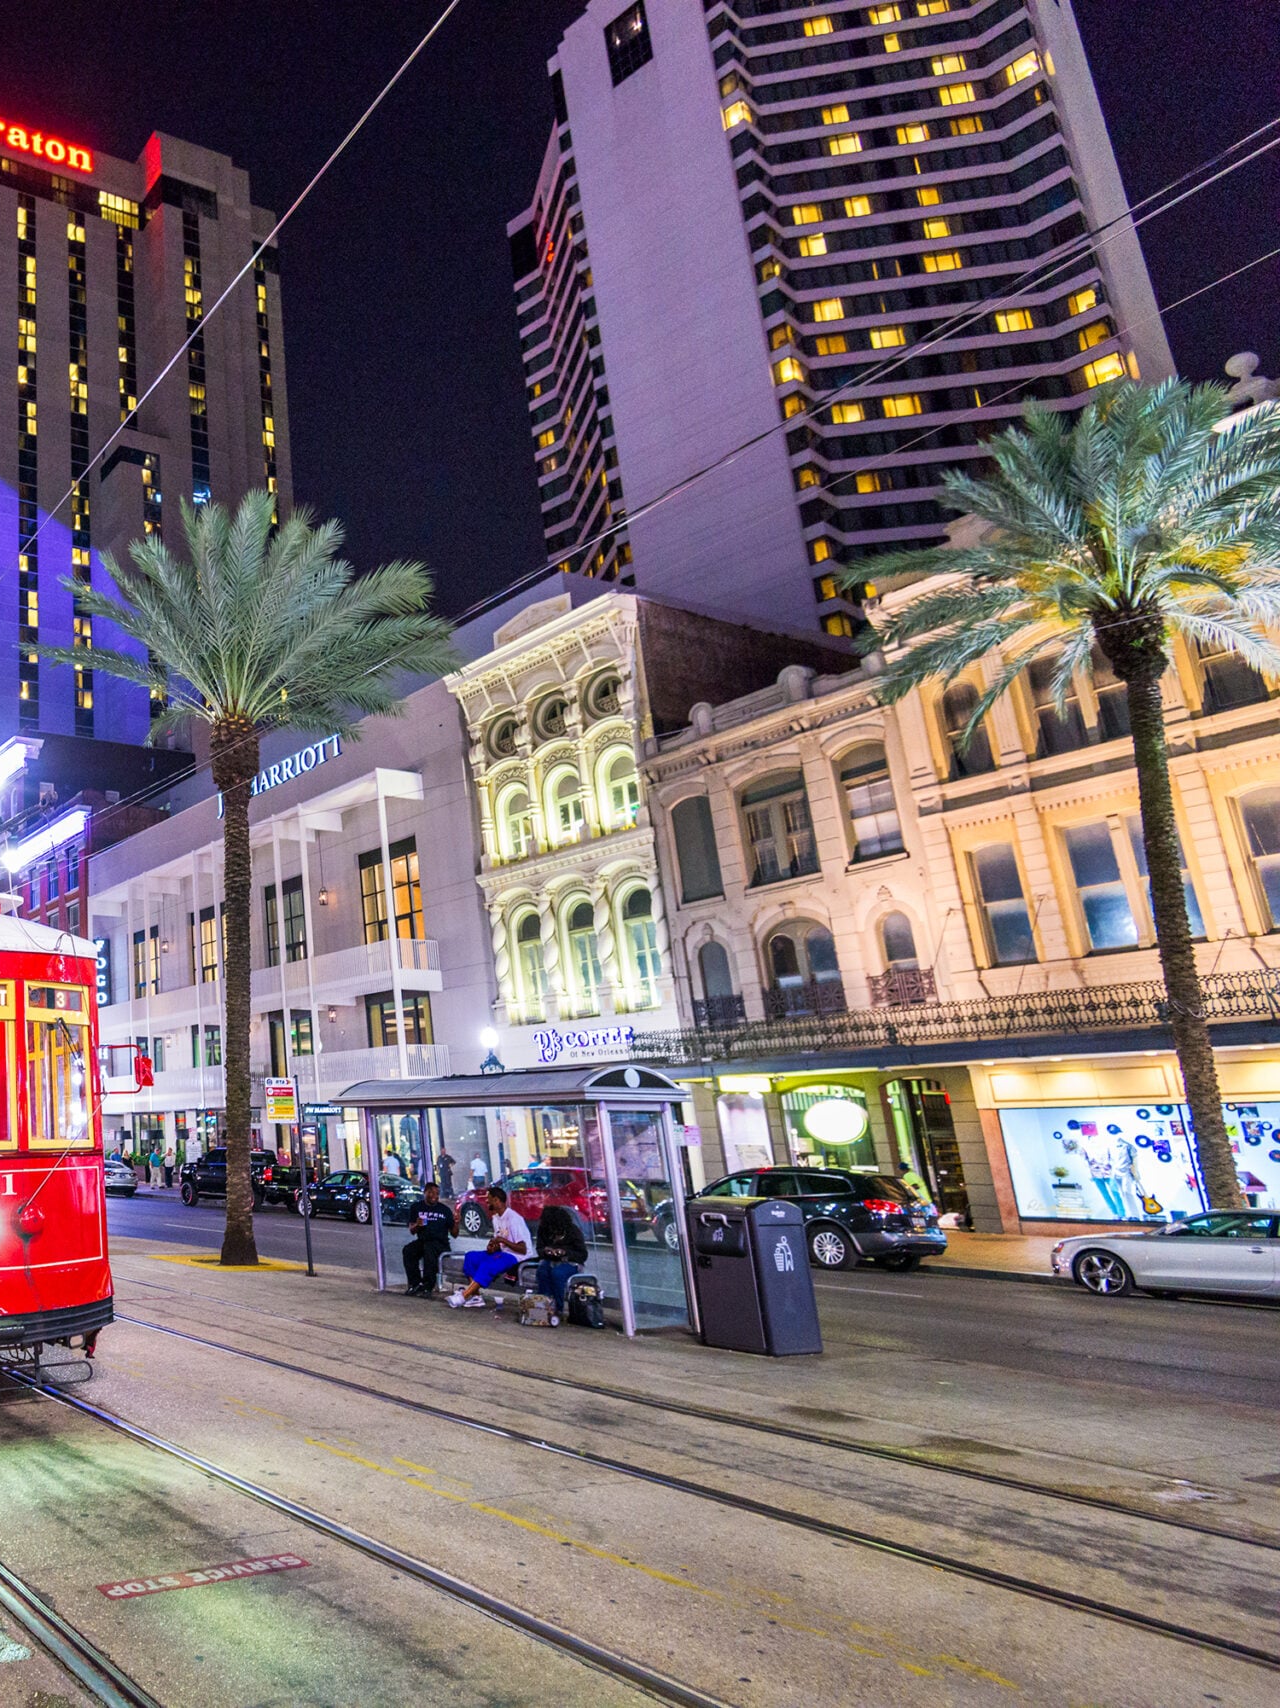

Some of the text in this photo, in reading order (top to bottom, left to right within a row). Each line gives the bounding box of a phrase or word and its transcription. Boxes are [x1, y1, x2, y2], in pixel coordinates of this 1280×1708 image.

[56, 992, 65, 1008] 3
[533, 1026, 635, 1062] PJ's COFFEE
[108, 1555, 302, 1597] SERVICE STOP
